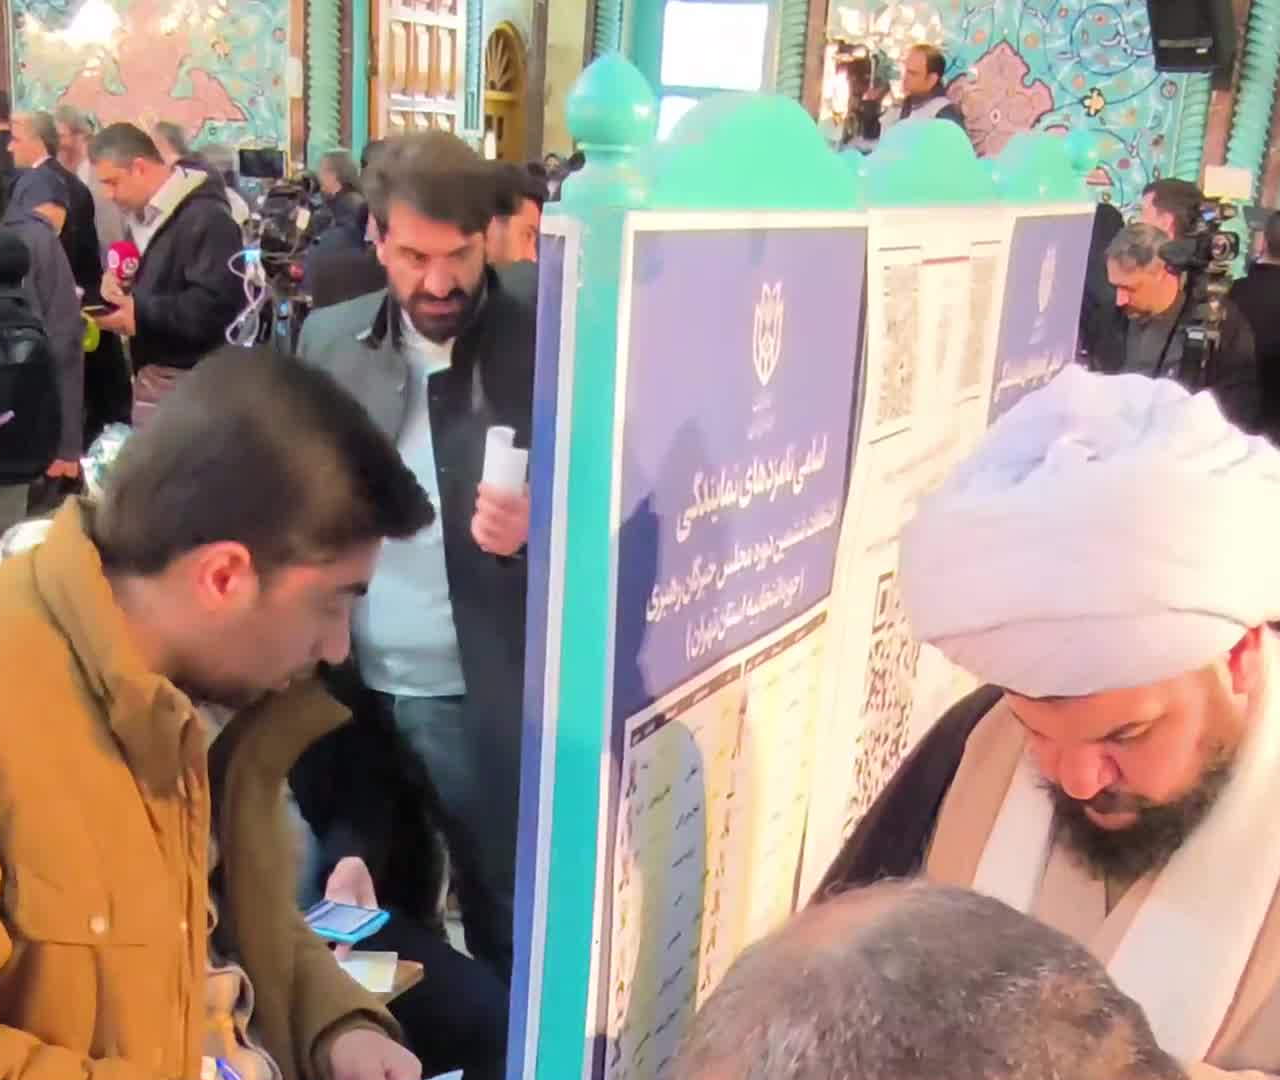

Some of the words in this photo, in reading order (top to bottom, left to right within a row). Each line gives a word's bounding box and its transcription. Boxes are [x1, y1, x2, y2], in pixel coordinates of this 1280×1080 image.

[737, 443, 794, 509] نامزدهای
[792, 433, 828, 496] اسامی
[676, 466, 738, 543] نمایندگی
